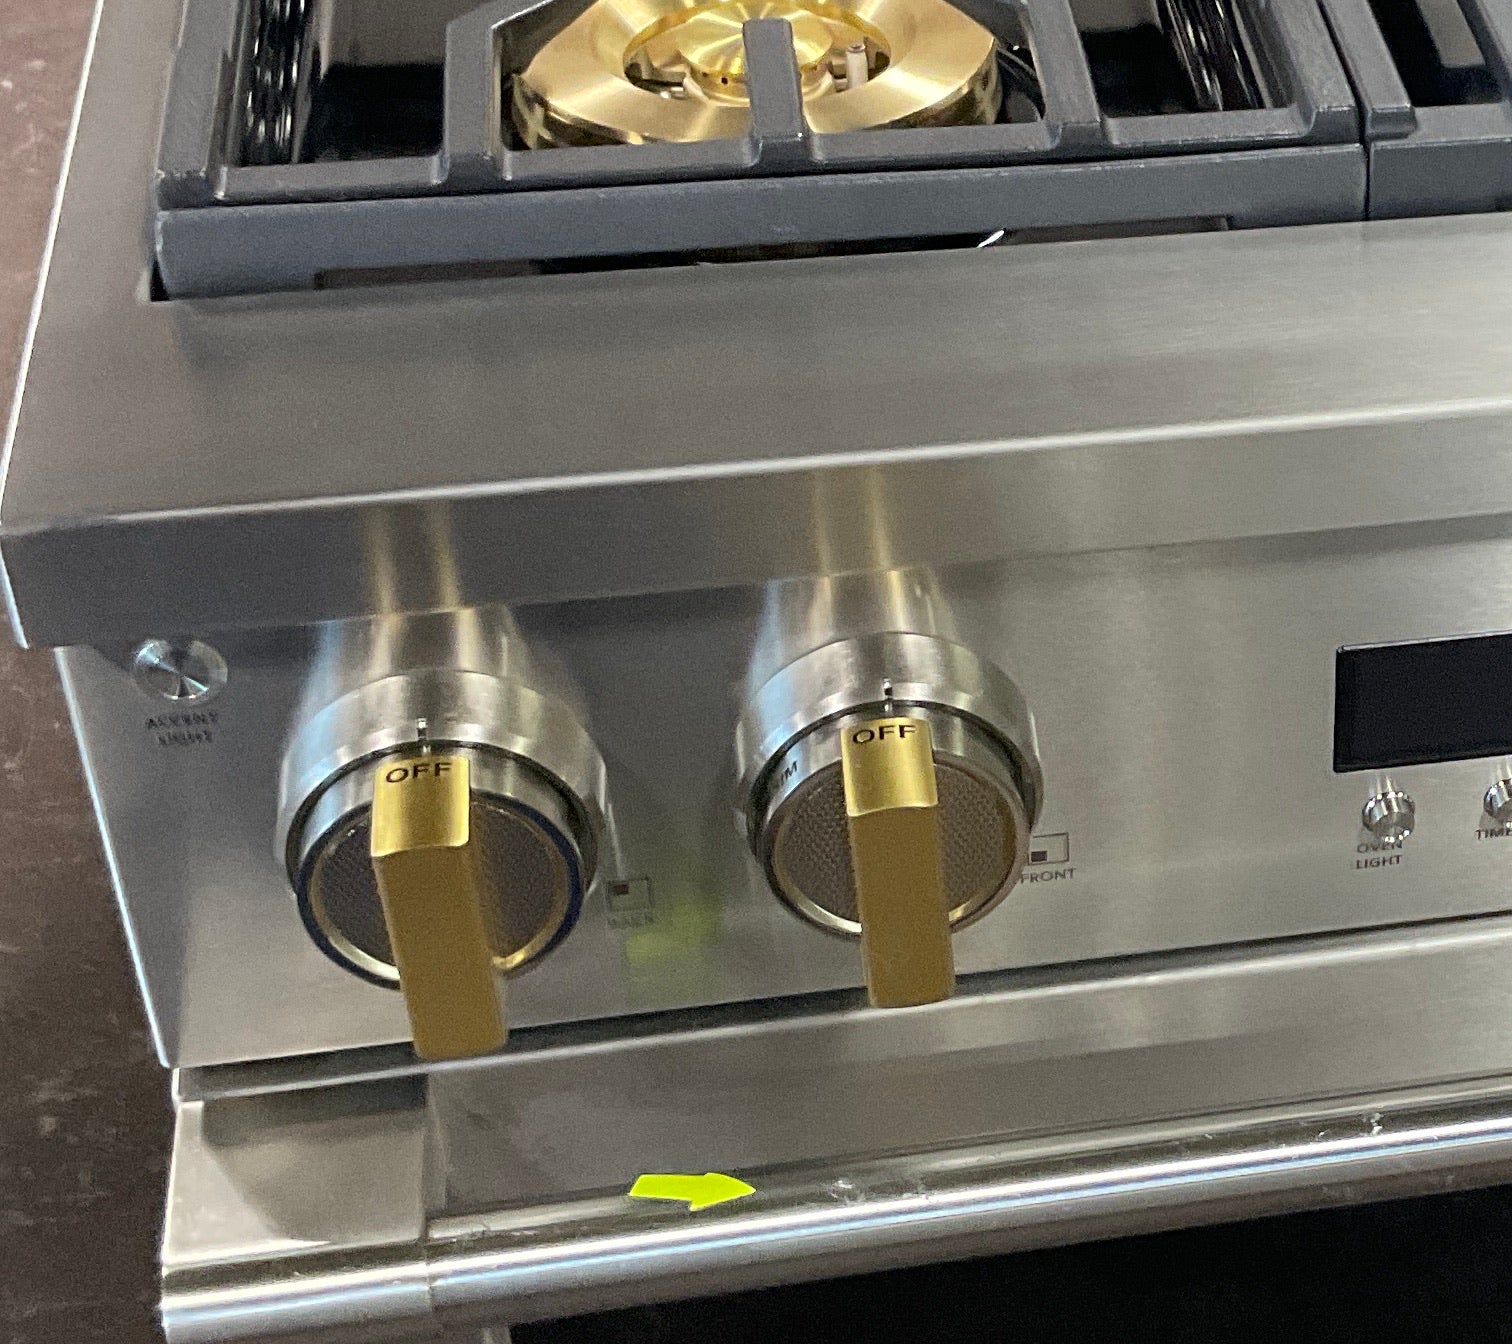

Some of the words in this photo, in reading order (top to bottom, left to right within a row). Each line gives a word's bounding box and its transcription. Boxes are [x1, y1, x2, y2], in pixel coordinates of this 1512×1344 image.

[852, 724, 917, 745] OFF
[385, 761, 453, 783] OFF
[1355, 854, 1403, 870] LIGHT
[1020, 866, 1077, 885] FRONT
